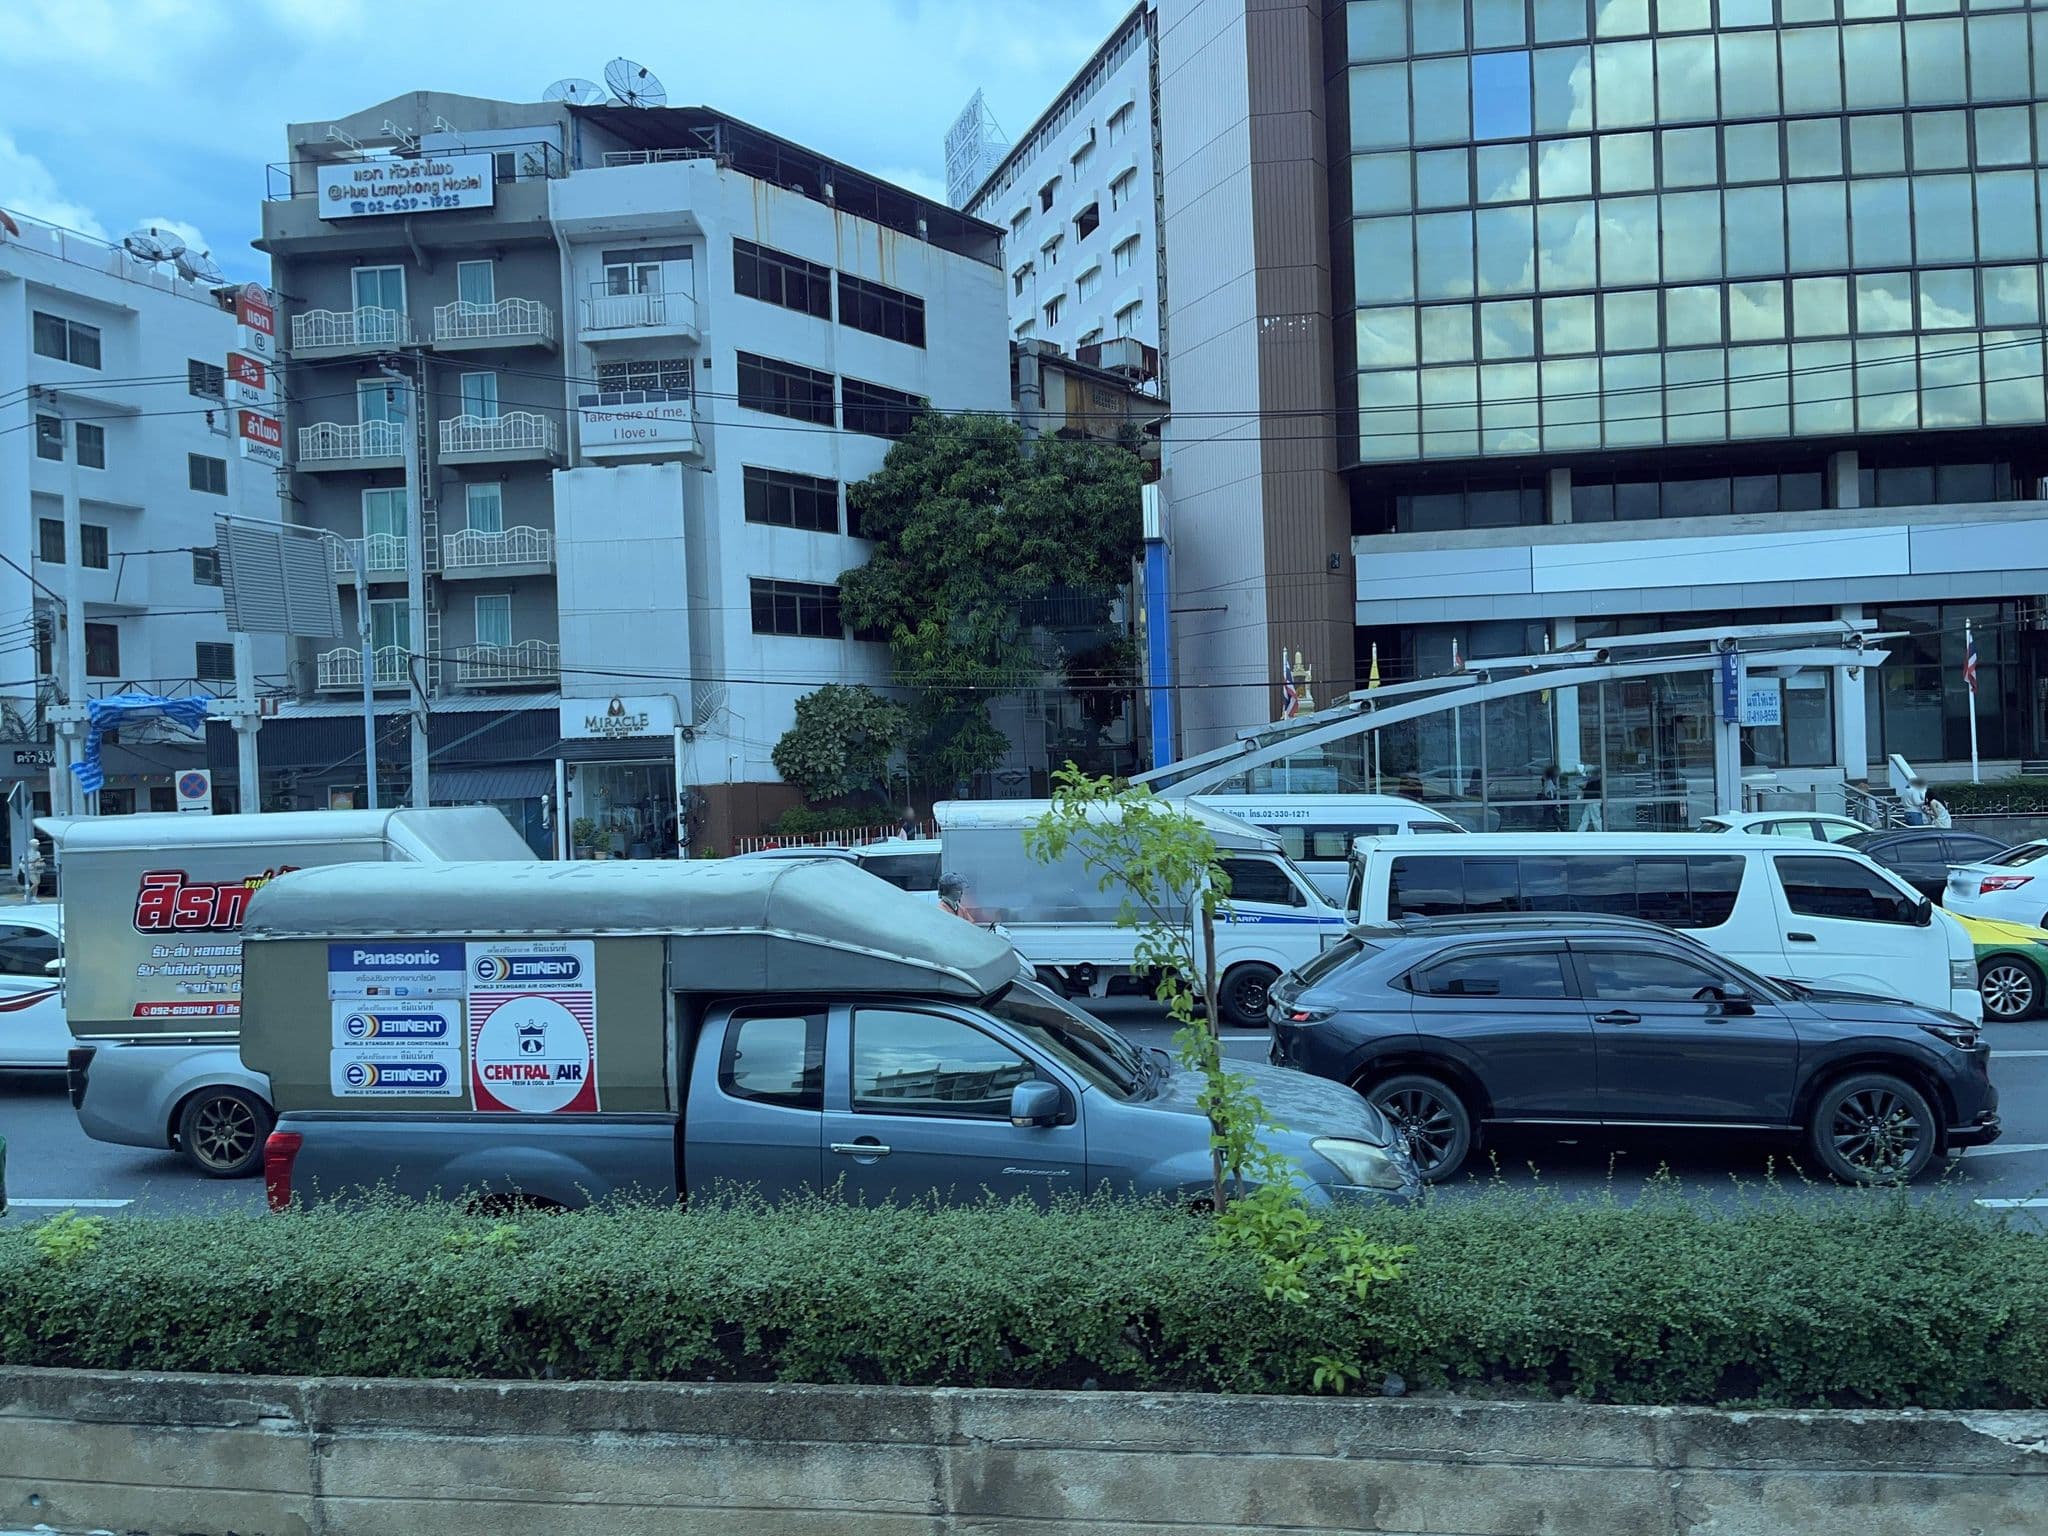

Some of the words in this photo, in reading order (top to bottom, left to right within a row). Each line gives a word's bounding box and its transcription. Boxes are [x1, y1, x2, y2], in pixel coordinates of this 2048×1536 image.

[371, 177, 439, 197] Lamphong
[442, 175, 481, 191] Hostel
[241, 359, 258, 382] หัว
[241, 386, 259, 402] HUA
[584, 411, 612, 423] Take
[616, 409, 643, 420] care
[646, 408, 658, 419] of
[662, 407, 687, 418] me.
[247, 416, 279, 442] ลำโพง
[621, 427, 646, 439] love
[650, 428, 657, 437] u
[247, 443, 281, 462] LAMPHONG
[584, 713, 649, 729] MIRACLE
[16, 751, 37, 763] ครัว
[353, 949, 440, 965] Panasonic
[484, 1064, 550, 1080] CENTRAL
[557, 1064, 582, 1080] AIR
